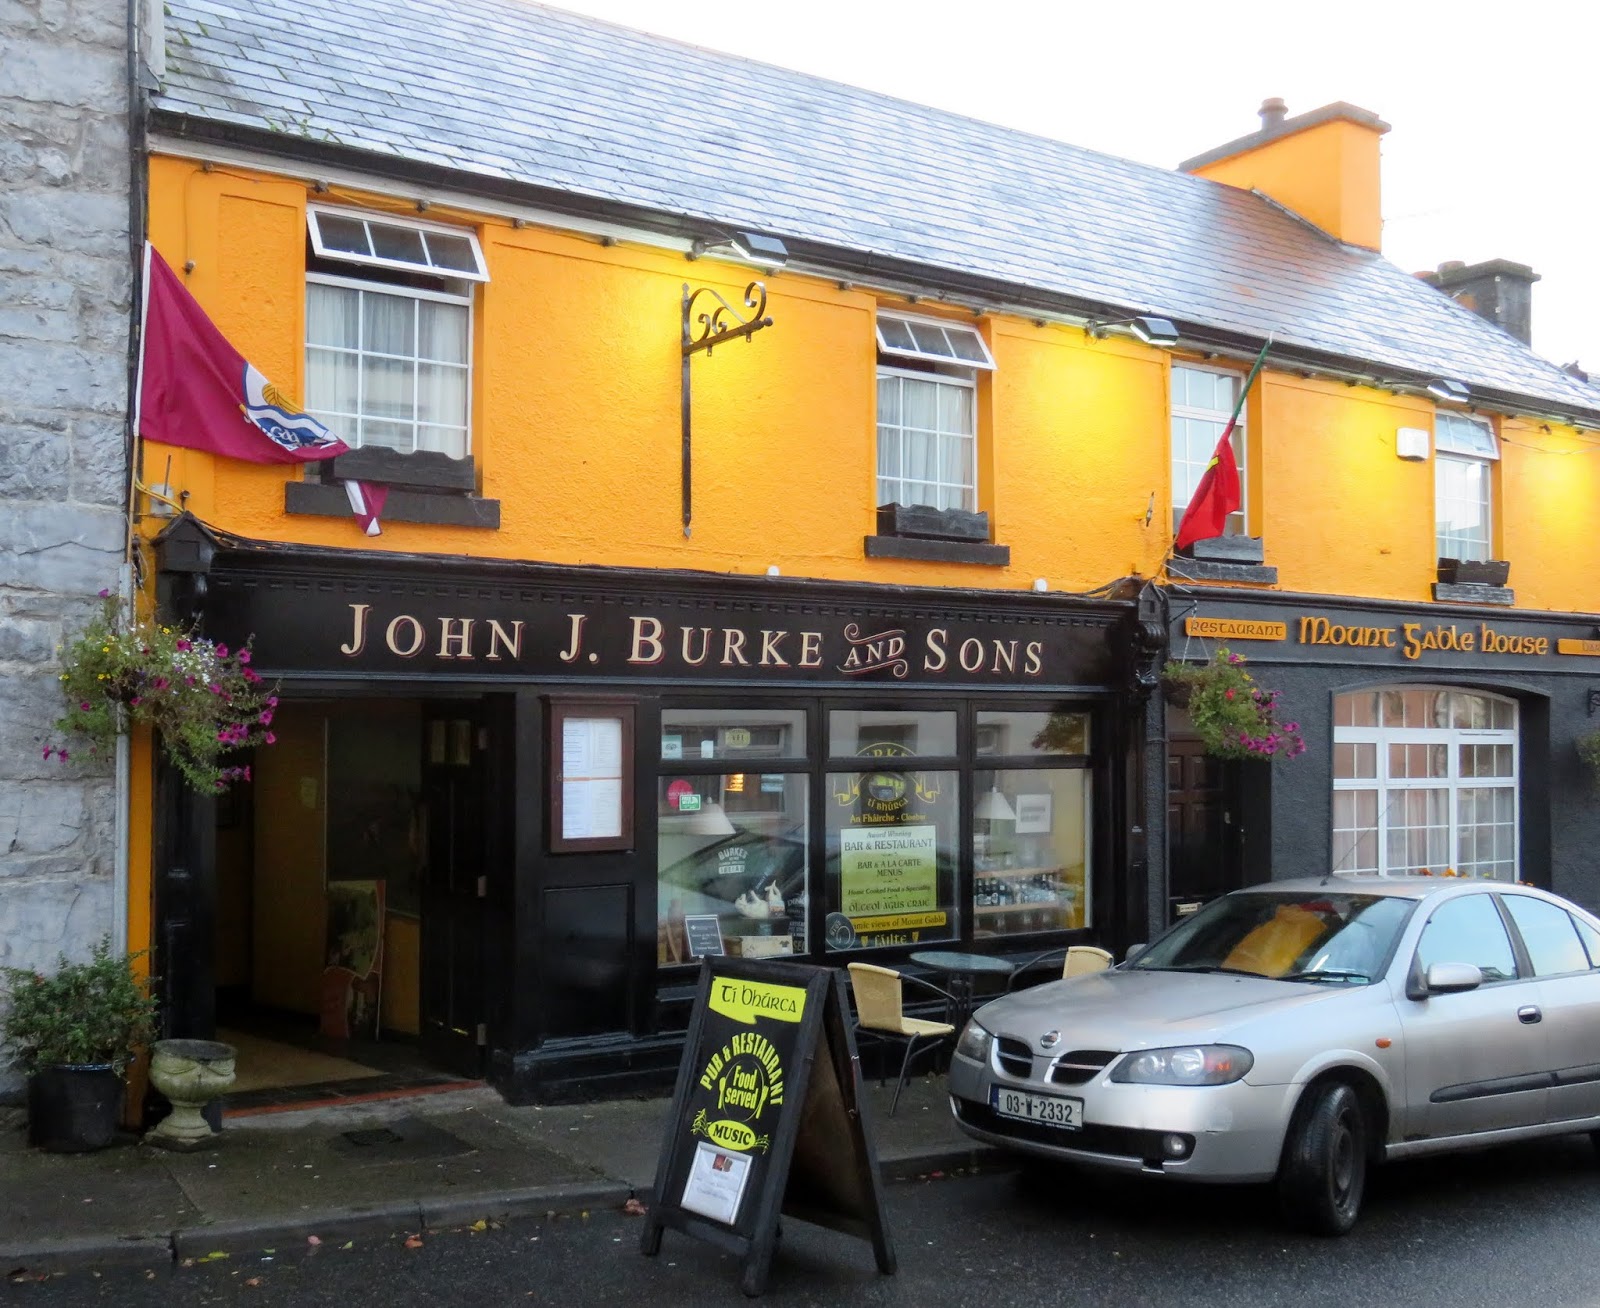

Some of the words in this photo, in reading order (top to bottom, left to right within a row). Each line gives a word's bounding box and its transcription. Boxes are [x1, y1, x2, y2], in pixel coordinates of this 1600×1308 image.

[340, 603, 524, 661] JOHN
[559, 614, 599, 664] J.
[626, 616, 825, 669] BURKE
[844, 637, 905, 668] AND
[923, 628, 1043, 676] SONS
[844, 841, 864, 851] BAR
[874, 838, 933, 850] RESTAURANT
[857, 861, 873, 870] BAR
[898, 858, 922, 867] CARTE
[877, 868, 903, 878] MENUS
[866, 887, 886, 895] Cooked
[871, 920, 891, 929] views
[892, 918, 899, 926] of
[900, 917, 924, 926] Mount
[924, 914, 945, 924] Gable
[700, 1052, 724, 1091] PUB
[722, 1044, 732, 1063] &
[732, 1032, 784, 1105] RESTAURANT
[732, 1065, 758, 1091] Food
[724, 1087, 759, 1110] served
[712, 1123, 752, 1146] MUSIC
